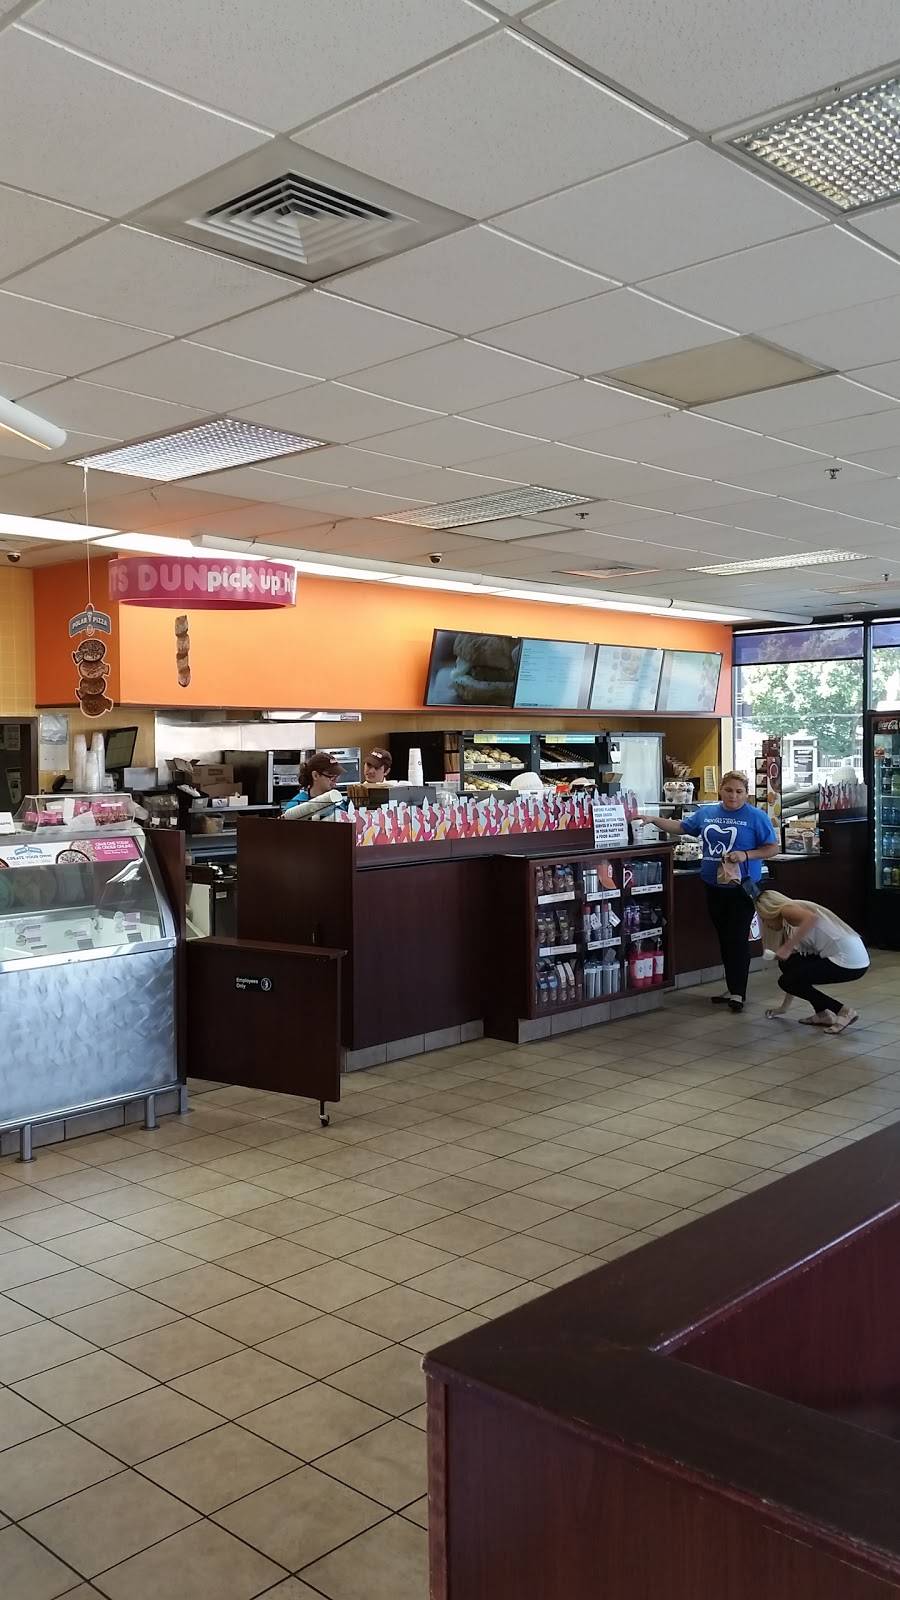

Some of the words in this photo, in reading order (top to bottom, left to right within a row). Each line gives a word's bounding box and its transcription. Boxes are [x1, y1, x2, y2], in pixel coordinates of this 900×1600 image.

[207, 566, 254, 593] pick
[261, 574, 281, 596] up
[93, 616, 108, 627] PIZZA
